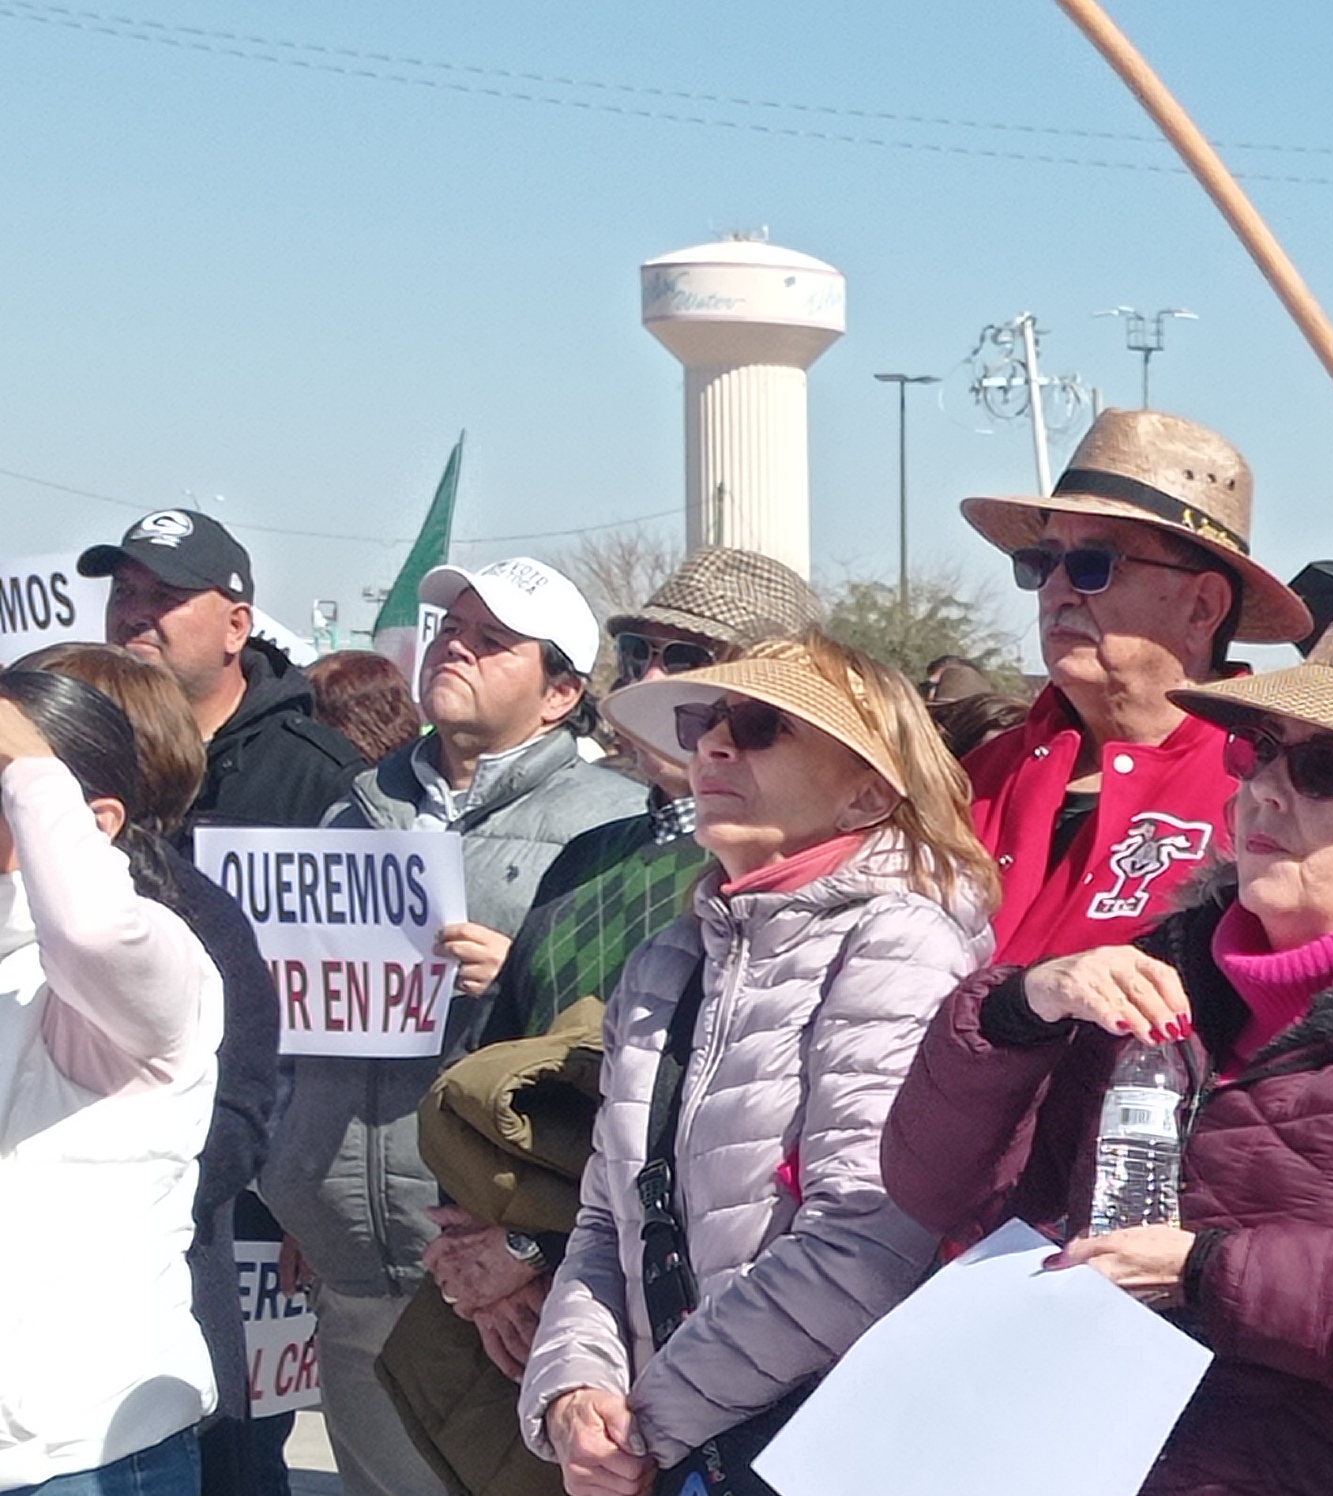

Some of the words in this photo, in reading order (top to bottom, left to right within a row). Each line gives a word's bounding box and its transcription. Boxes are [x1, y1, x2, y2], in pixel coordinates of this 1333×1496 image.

[220, 850, 429, 927] QUEREMOS
[321, 960, 370, 1032] EN
[381, 961, 447, 1033] PAZ
